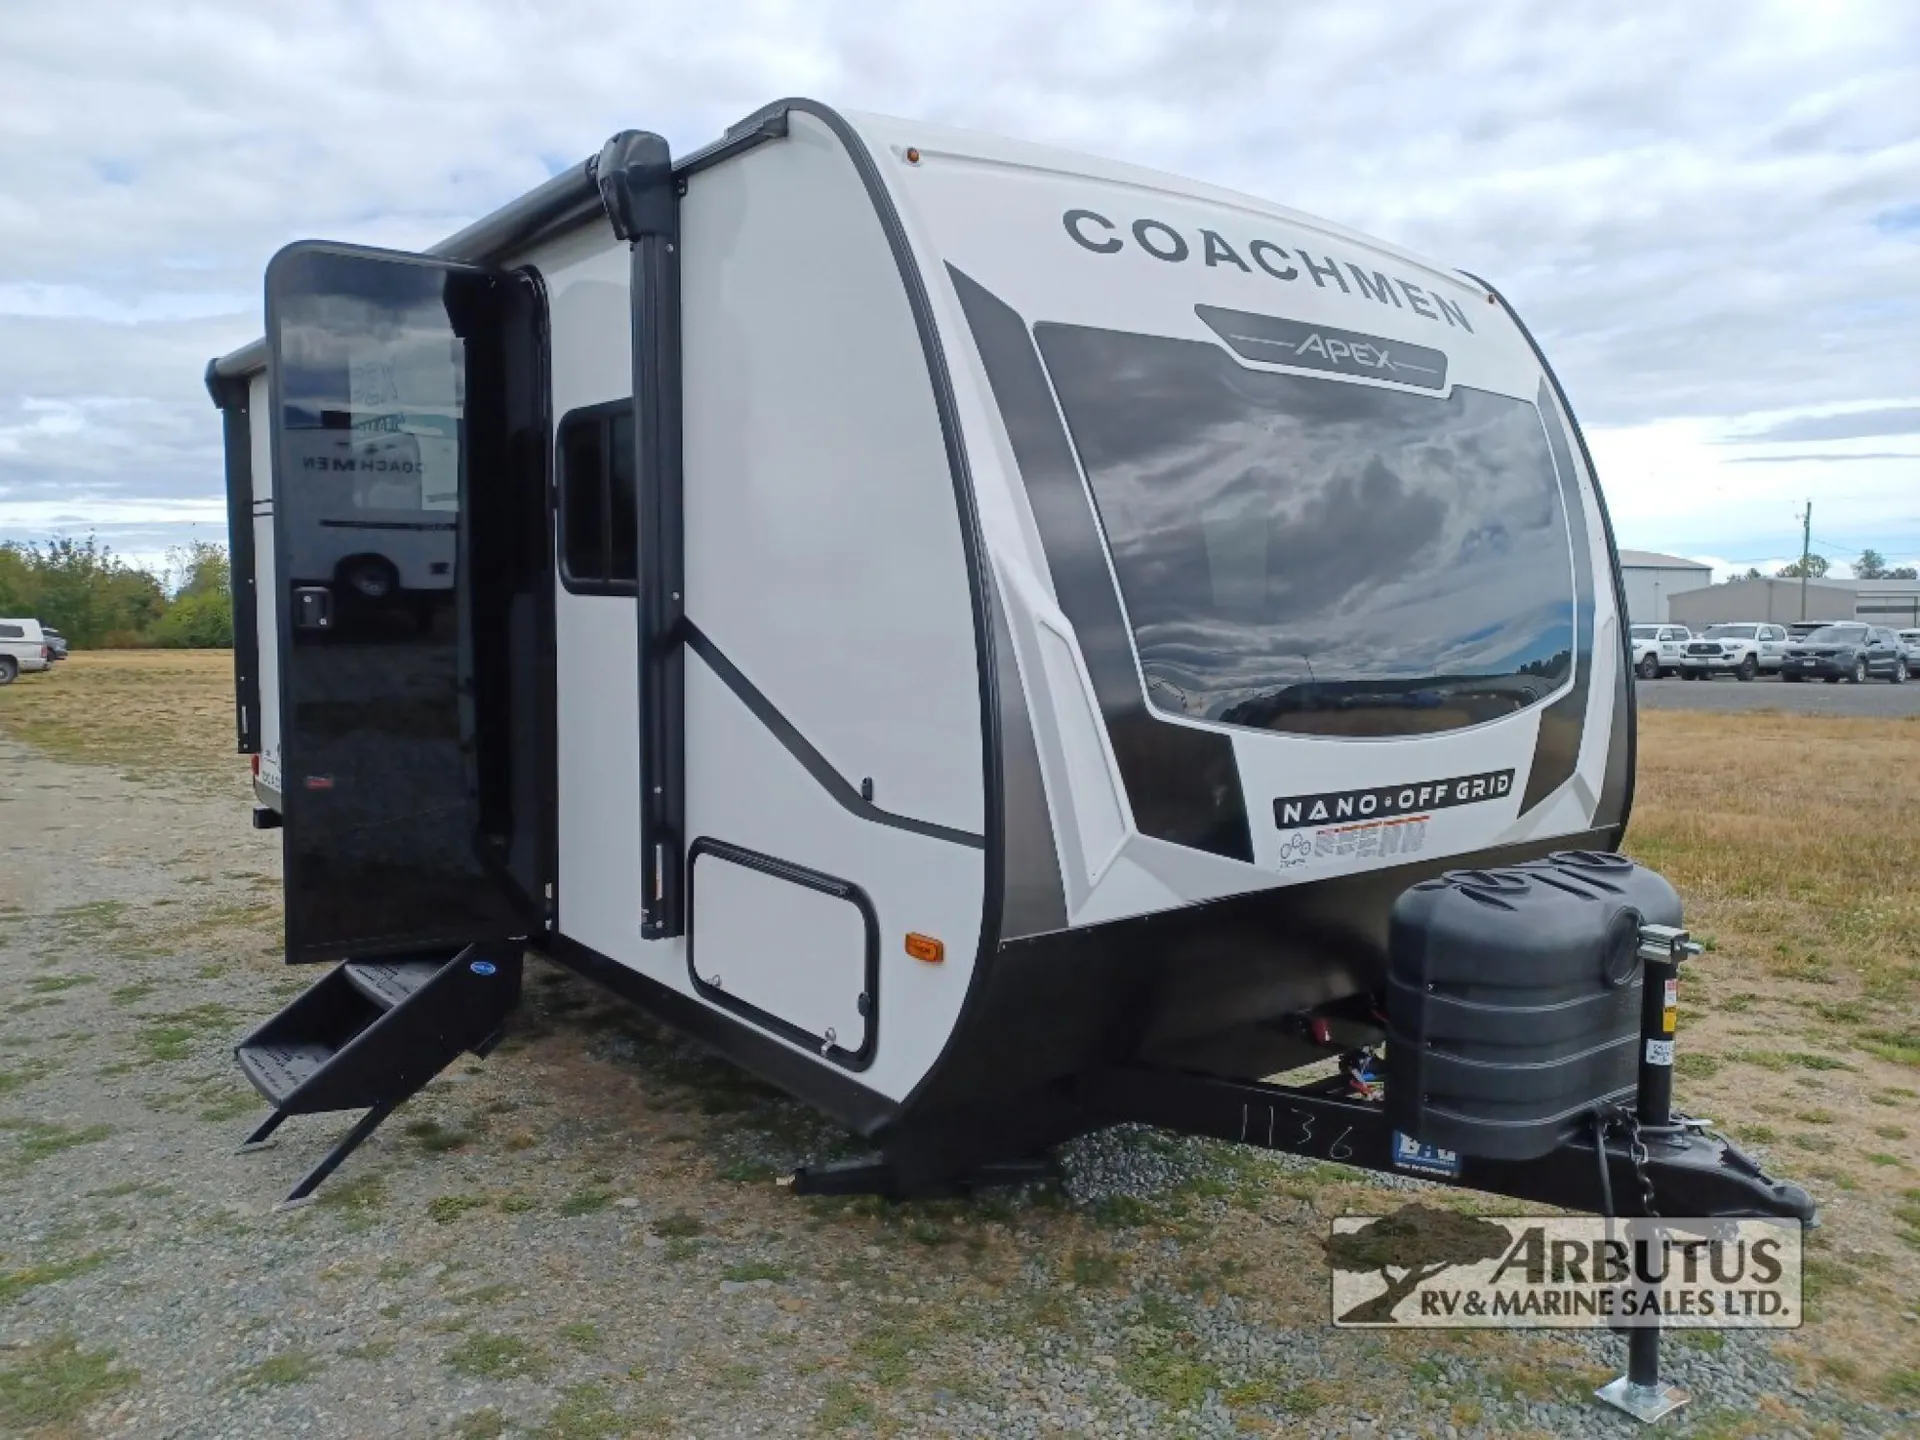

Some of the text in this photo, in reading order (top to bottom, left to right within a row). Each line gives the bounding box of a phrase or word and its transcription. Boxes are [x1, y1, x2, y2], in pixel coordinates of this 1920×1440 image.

[1063, 209, 1475, 334] COACHMEN
[1295, 333, 1400, 370] APEX
[1283, 774, 1510, 824] NANO OFF GRID
